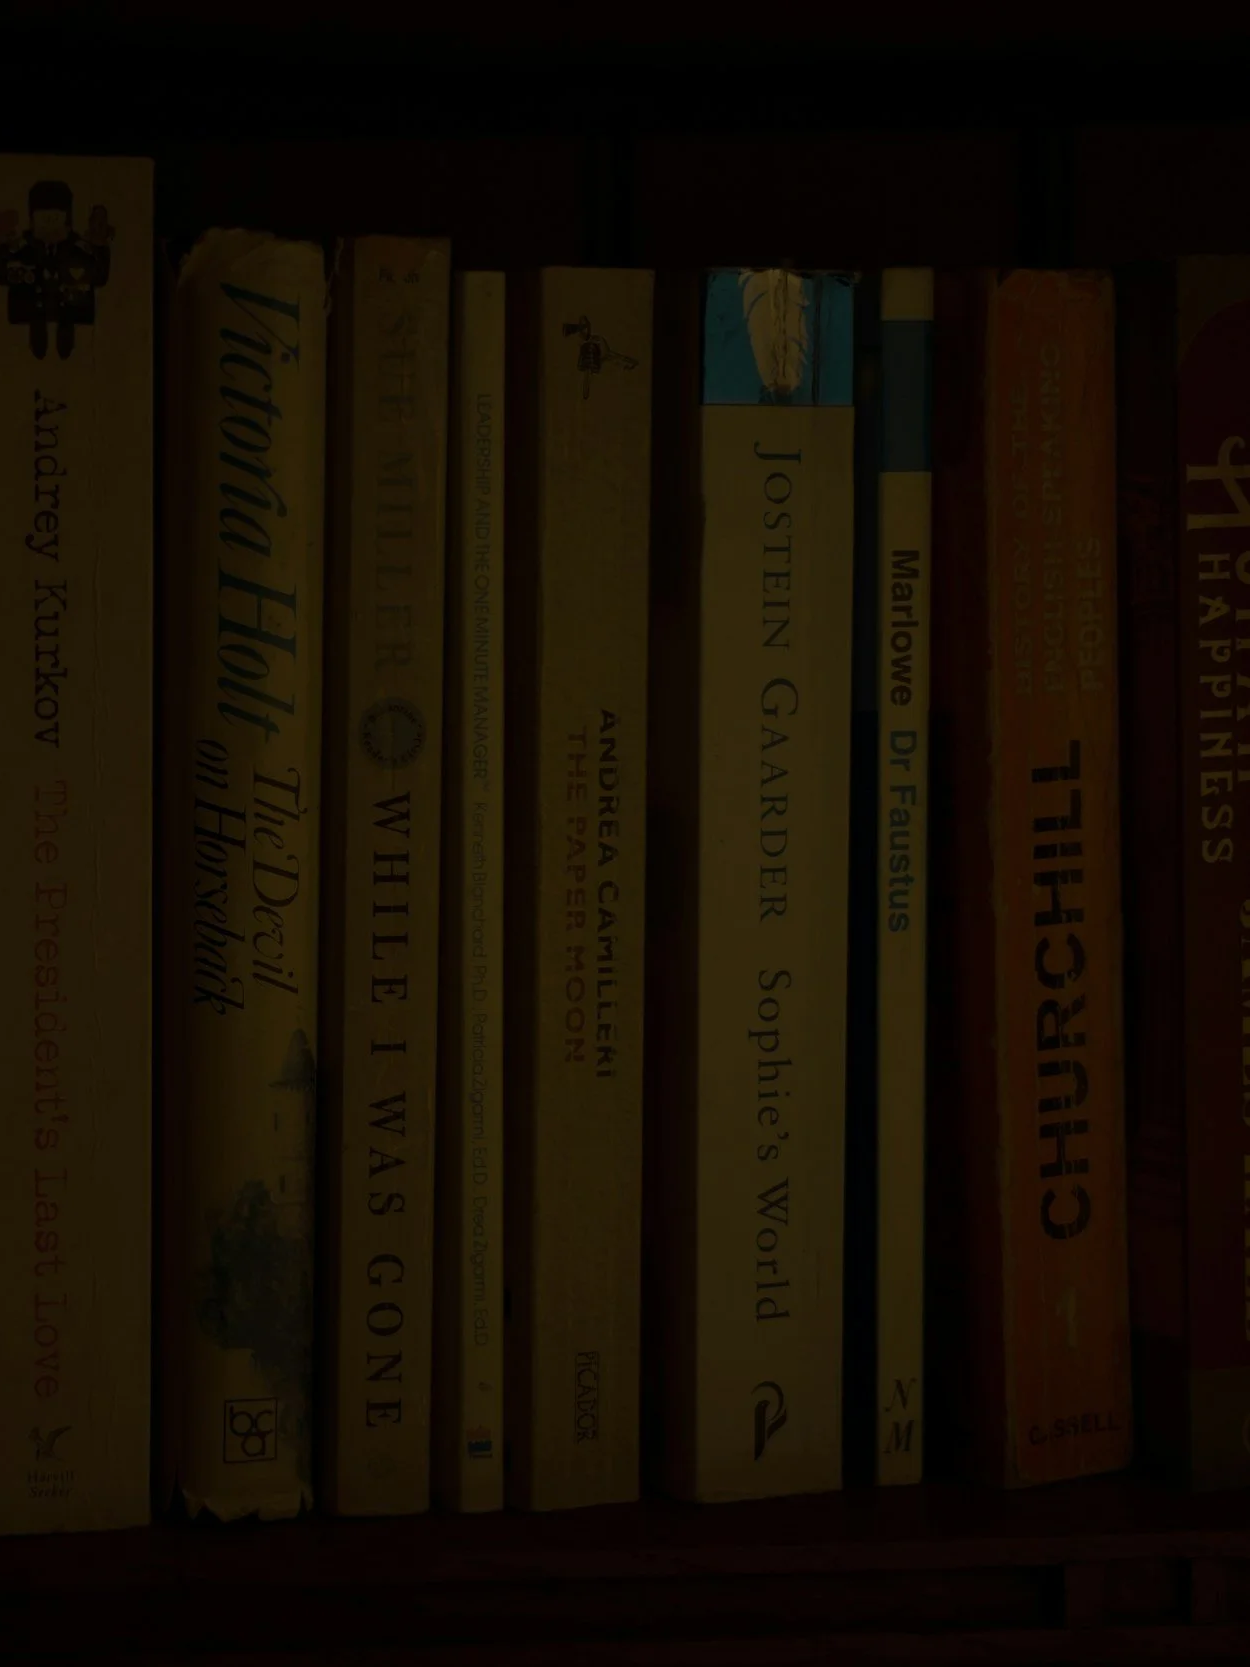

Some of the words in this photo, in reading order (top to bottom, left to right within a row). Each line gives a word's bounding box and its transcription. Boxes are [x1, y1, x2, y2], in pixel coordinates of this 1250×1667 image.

[217, 282, 301, 559] Victoria
[373, 309, 414, 429] SUE
[1009, 385, 1029, 458] THE
[25, 389, 67, 563] Andrey
[474, 392, 493, 496] LEADERSHIP
[1010, 470, 1030, 520] OF
[373, 449, 415, 674] MILLER
[474, 498, 492, 540] AND
[474, 543, 492, 573] THE
[753, 441, 803, 652] JOSTEIN
[473, 617, 492, 682] MINUTE
[474, 574, 492, 617] ONE
[889, 549, 920, 706] Marlowe
[1076, 535, 1106, 692] PEOPLES
[31, 578, 68, 749] Kurkov
[216, 570, 297, 745] Holt
[1198, 552, 1234, 865] HAPPINESS
[194, 738, 235, 791] on
[250, 765, 308, 851] The
[566, 724, 589, 802] THE
[596, 707, 620, 870] ANDREA
[758, 676, 800, 924] GAARDER
[890, 729, 916, 772] Dr
[32, 780, 68, 865] The
[470, 800, 488, 869] Kenneth
[565, 814, 589, 932] PAPER
[888, 783, 917, 933] Faustus
[191, 797, 249, 1017] Horseback
[250, 854, 301, 995] Devil
[370, 791, 411, 1004] WHILE
[469, 871, 488, 958] Blanchard
[33, 880, 72, 1152] President's
[563, 946, 585, 1064] MOON
[594, 879, 619, 1080] CAMILLERI
[1031, 739, 1092, 1241] CHURCHILL
[369, 1040, 406, 1057] I
[747, 968, 792, 1164] Sophie's
[367, 1092, 406, 1218] WAS
[472, 1195, 488, 1238] Drea
[32, 1167, 68, 1278] Last
[754, 1178, 790, 1324] World
[32, 1292, 67, 1399] Love
[365, 1253, 404, 1430] GONE
[575, 1352, 598, 1444] PICADOR
